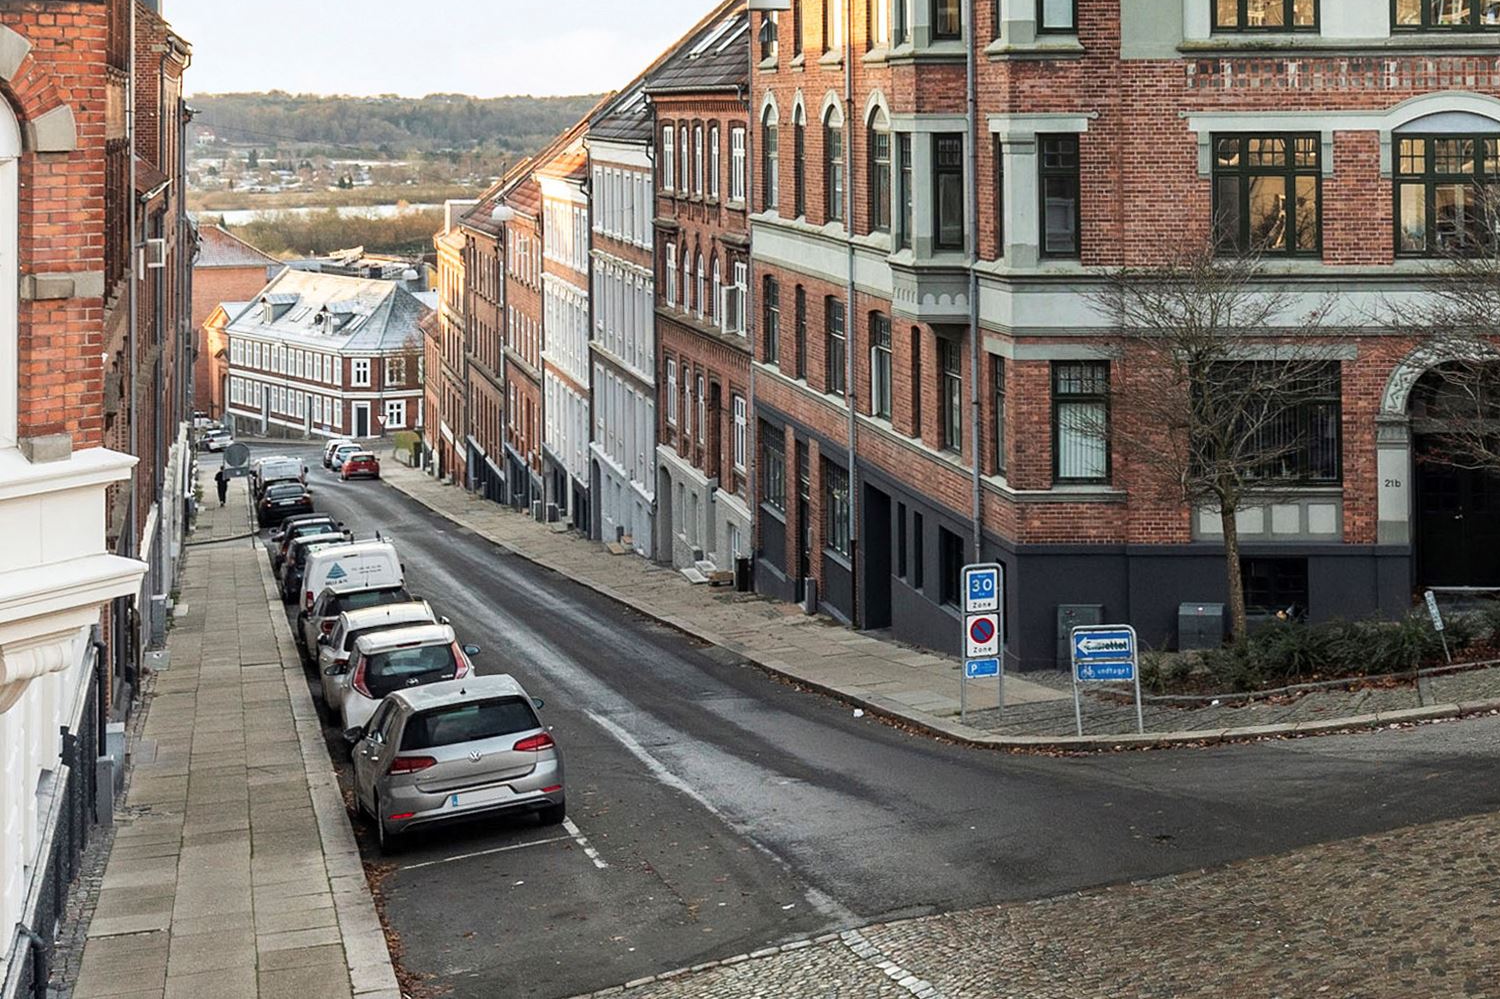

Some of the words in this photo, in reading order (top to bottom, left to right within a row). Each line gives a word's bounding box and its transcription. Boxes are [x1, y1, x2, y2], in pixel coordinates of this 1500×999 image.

[1384, 479, 1402, 488] 21b
[972, 578, 993, 593] 30
[972, 601, 992, 609] Zone
[973, 646, 992, 654] Zone
